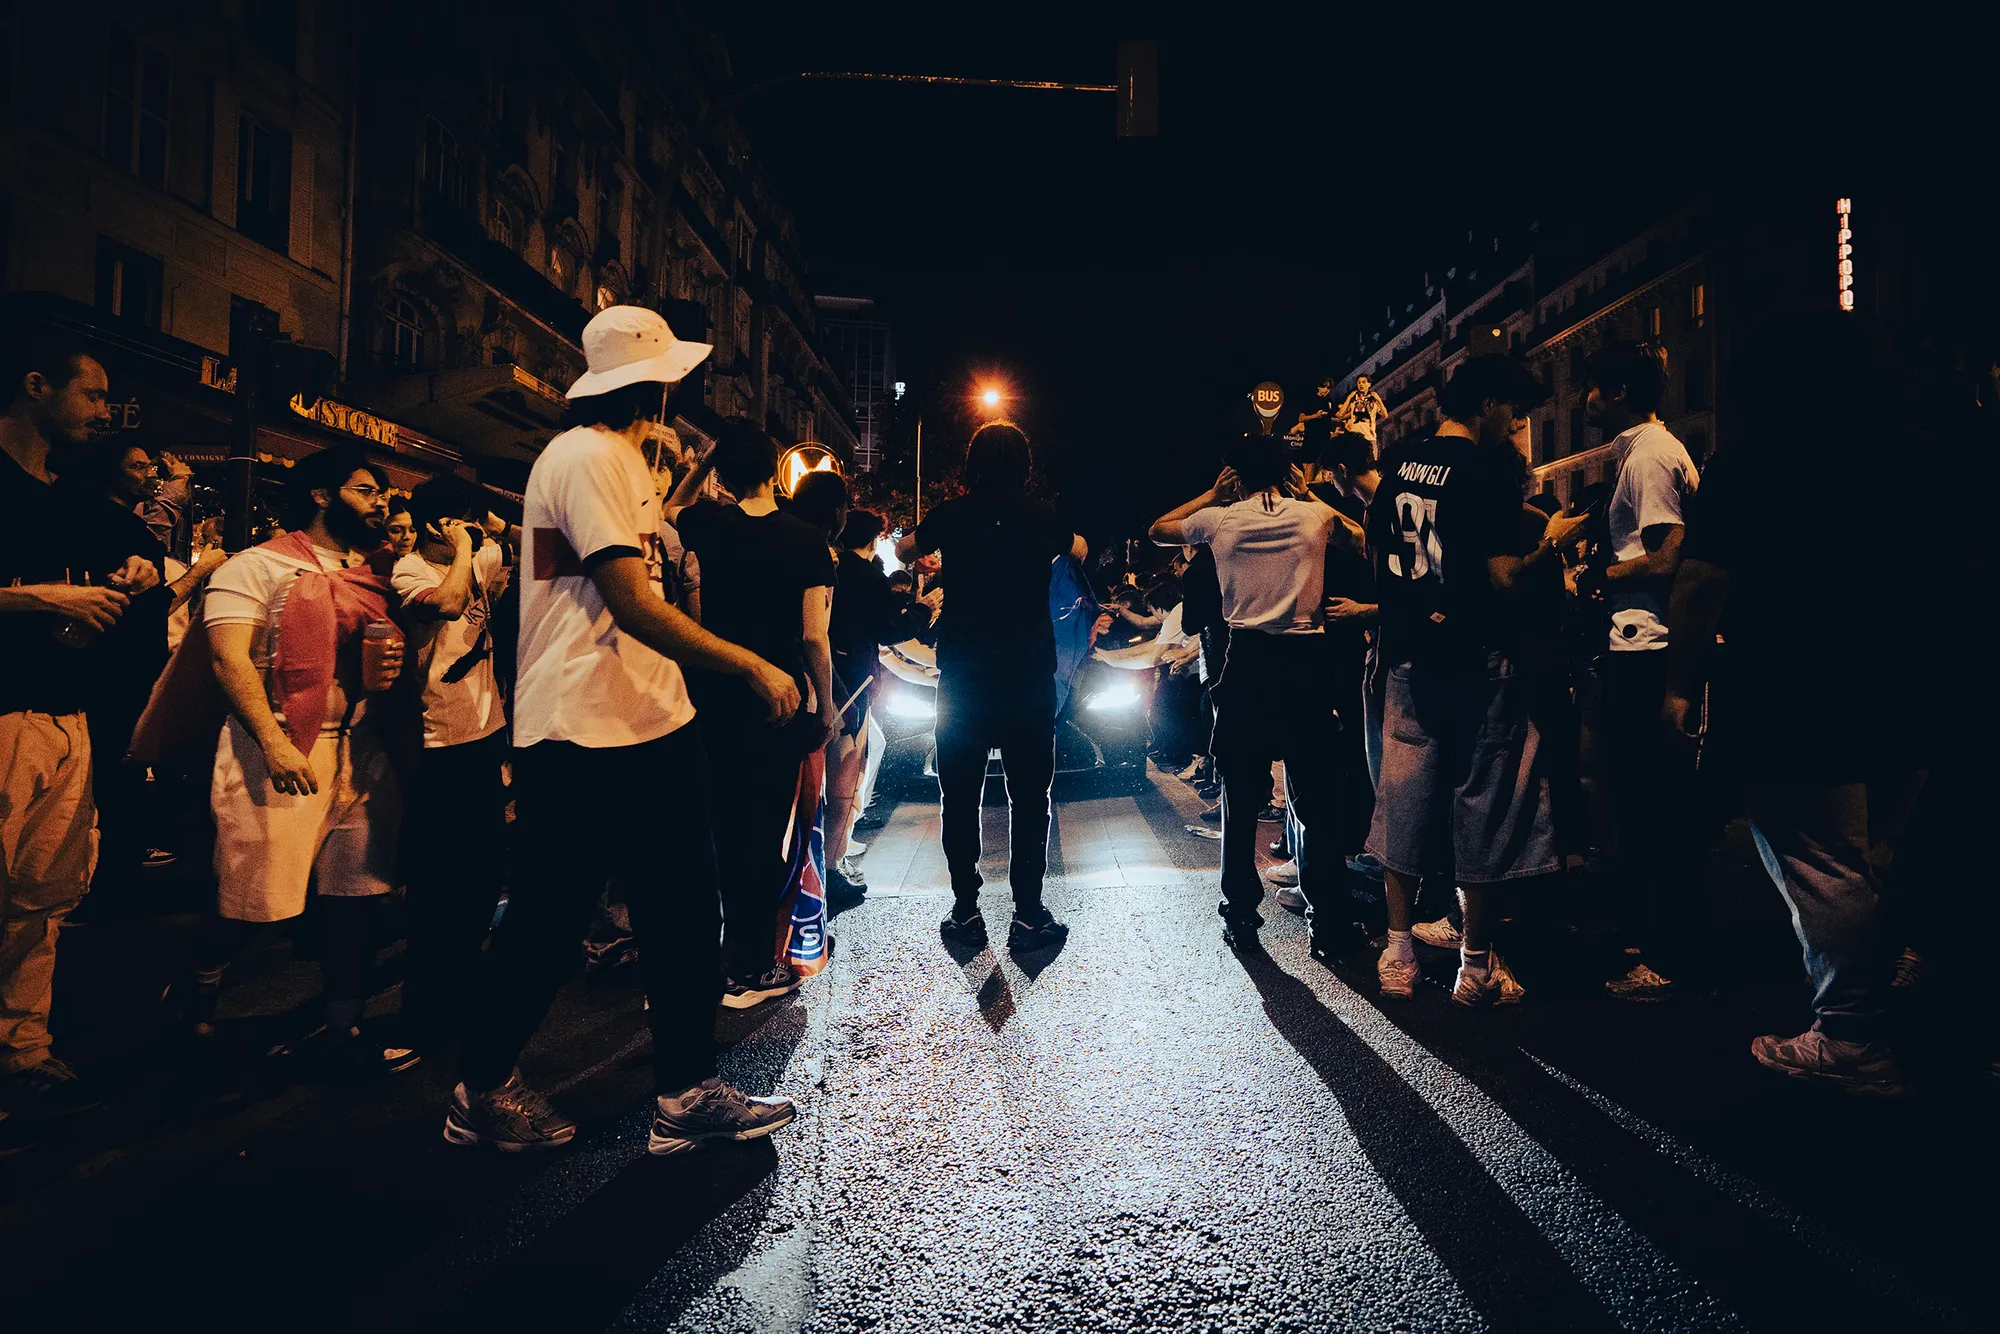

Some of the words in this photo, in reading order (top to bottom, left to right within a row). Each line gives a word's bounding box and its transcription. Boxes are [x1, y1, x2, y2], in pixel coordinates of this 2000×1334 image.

[1836, 197, 1855, 312] HIPPOPO
[105, 396, 141, 429] FÉ
[1257, 390, 1280, 402] BUS
[1397, 461, 1452, 487] MOWGLI
[1387, 491, 1445, 584] 91
